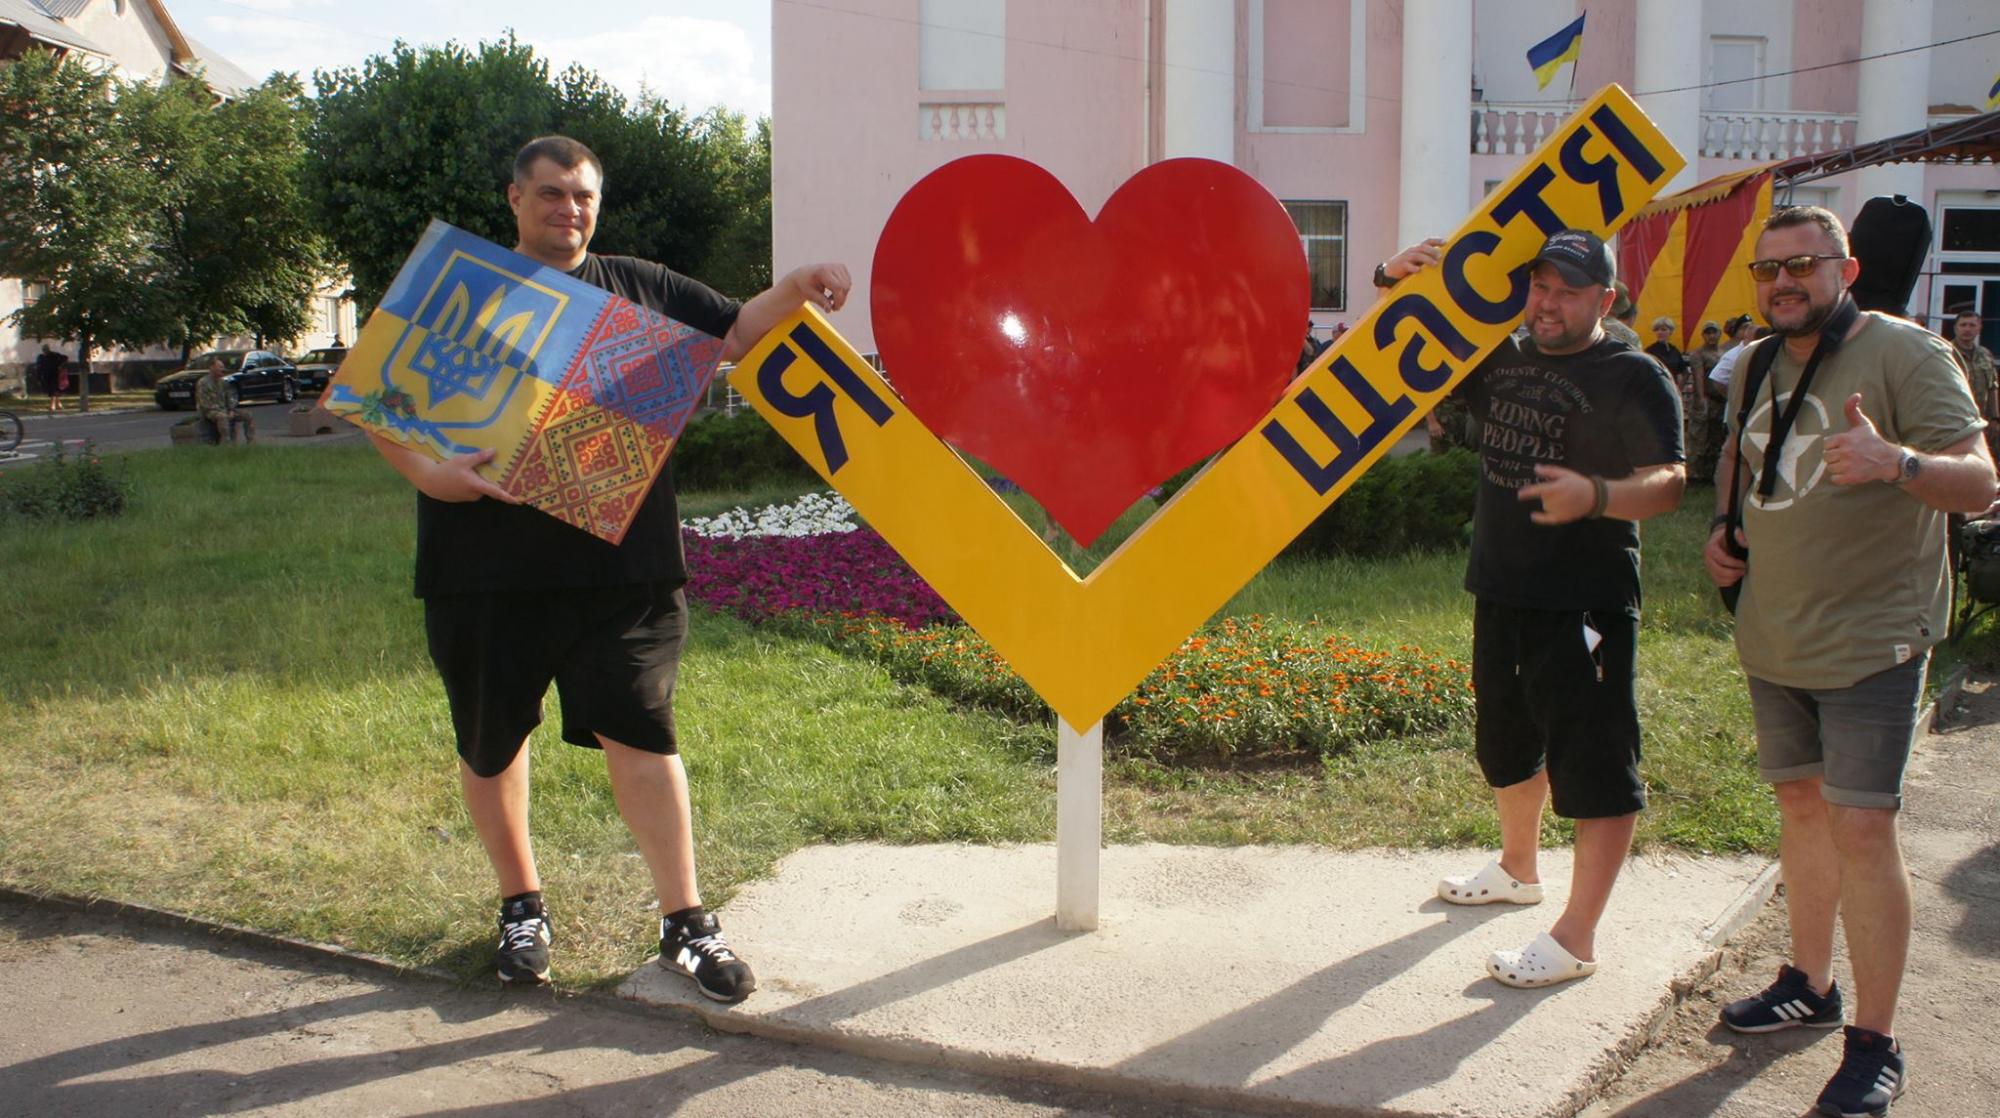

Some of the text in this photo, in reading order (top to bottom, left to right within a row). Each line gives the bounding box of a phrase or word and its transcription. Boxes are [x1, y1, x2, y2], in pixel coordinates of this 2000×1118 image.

[757, 321, 895, 477] Я
[1543, 369, 1594, 415] CLOTHING
[1487, 396, 1566, 439] RIDING
[1482, 422, 1565, 461] PEOPLE
